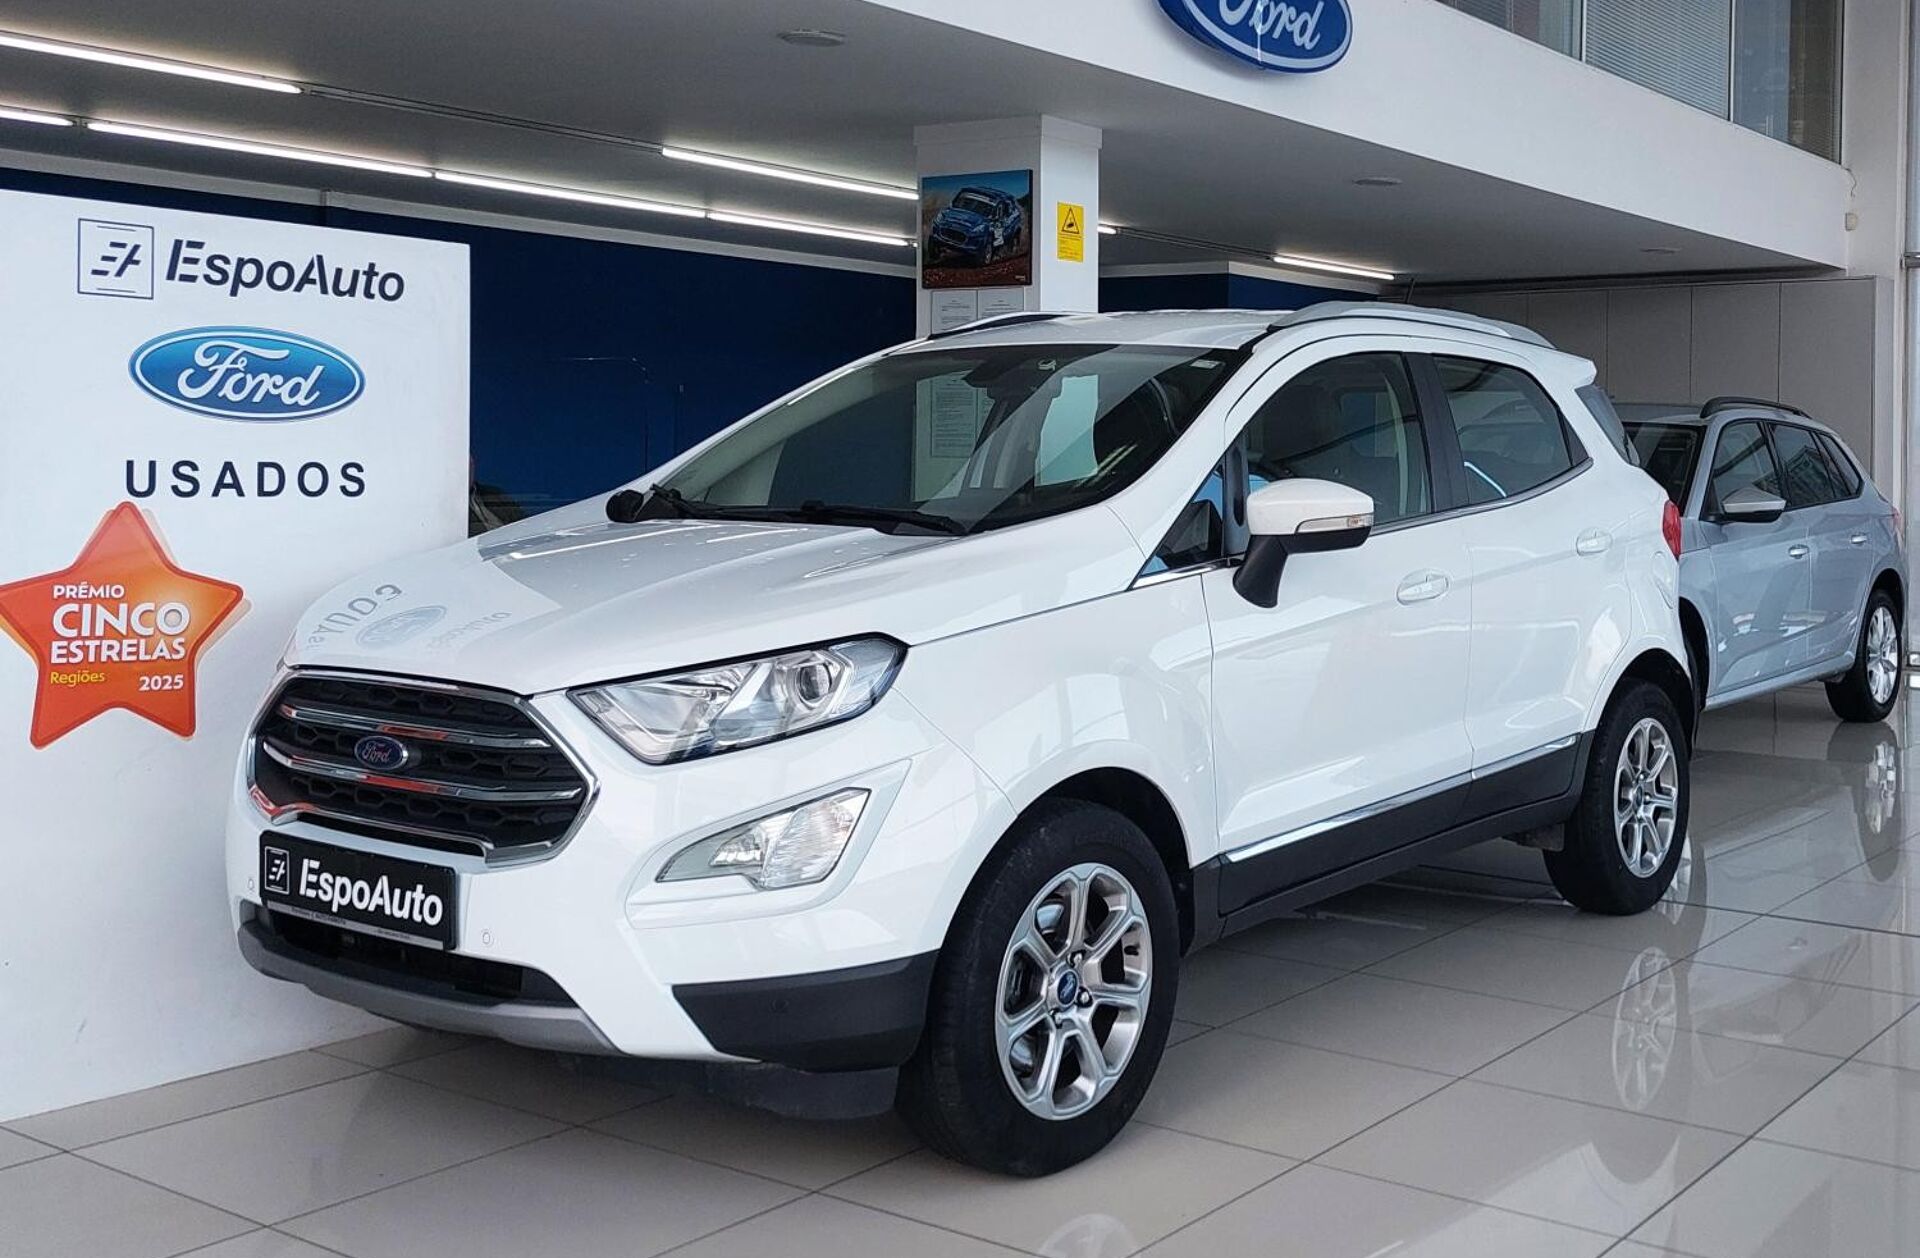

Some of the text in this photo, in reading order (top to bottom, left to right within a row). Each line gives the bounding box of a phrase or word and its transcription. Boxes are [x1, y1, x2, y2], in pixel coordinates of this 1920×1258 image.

[165, 238, 405, 302] EspoAuto
[176, 340, 325, 407] Ford
[125, 459, 367, 498] USADOS
[53, 581, 126, 600] PRÉMIO
[52, 602, 191, 638] CINCO
[50, 638, 187, 665] ESTRELAS
[50, 669, 106, 688] Regiões
[138, 674, 185, 692] 2025
[361, 740, 393, 764] Ford
[299, 857, 444, 927] EspoAuto
